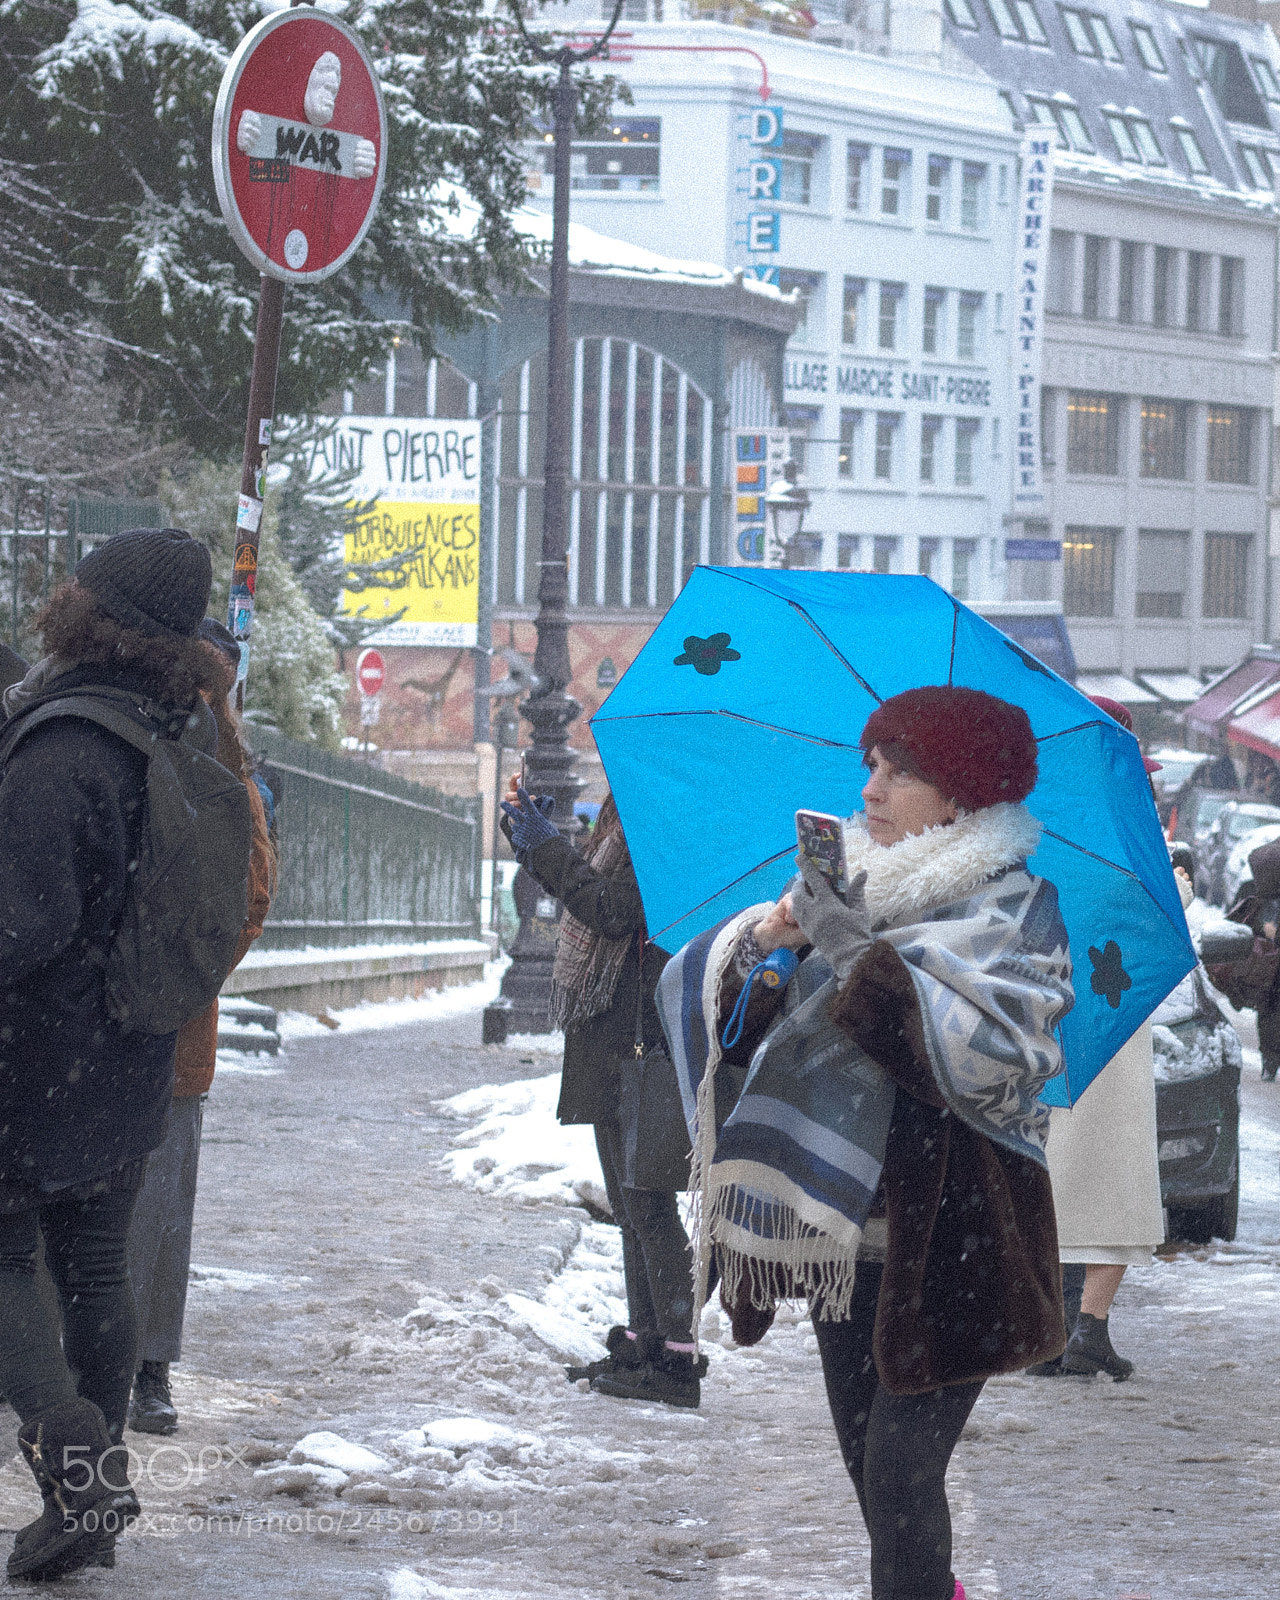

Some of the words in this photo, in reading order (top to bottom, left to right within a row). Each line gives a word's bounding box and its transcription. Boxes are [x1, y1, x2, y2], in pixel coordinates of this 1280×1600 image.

[275, 126, 342, 171] WAR
[307, 427, 373, 475] AINT
[383, 428, 477, 482] PIERRE
[737, 435, 766, 560] ALLE
[352, 513, 476, 550] TURBULENCES
